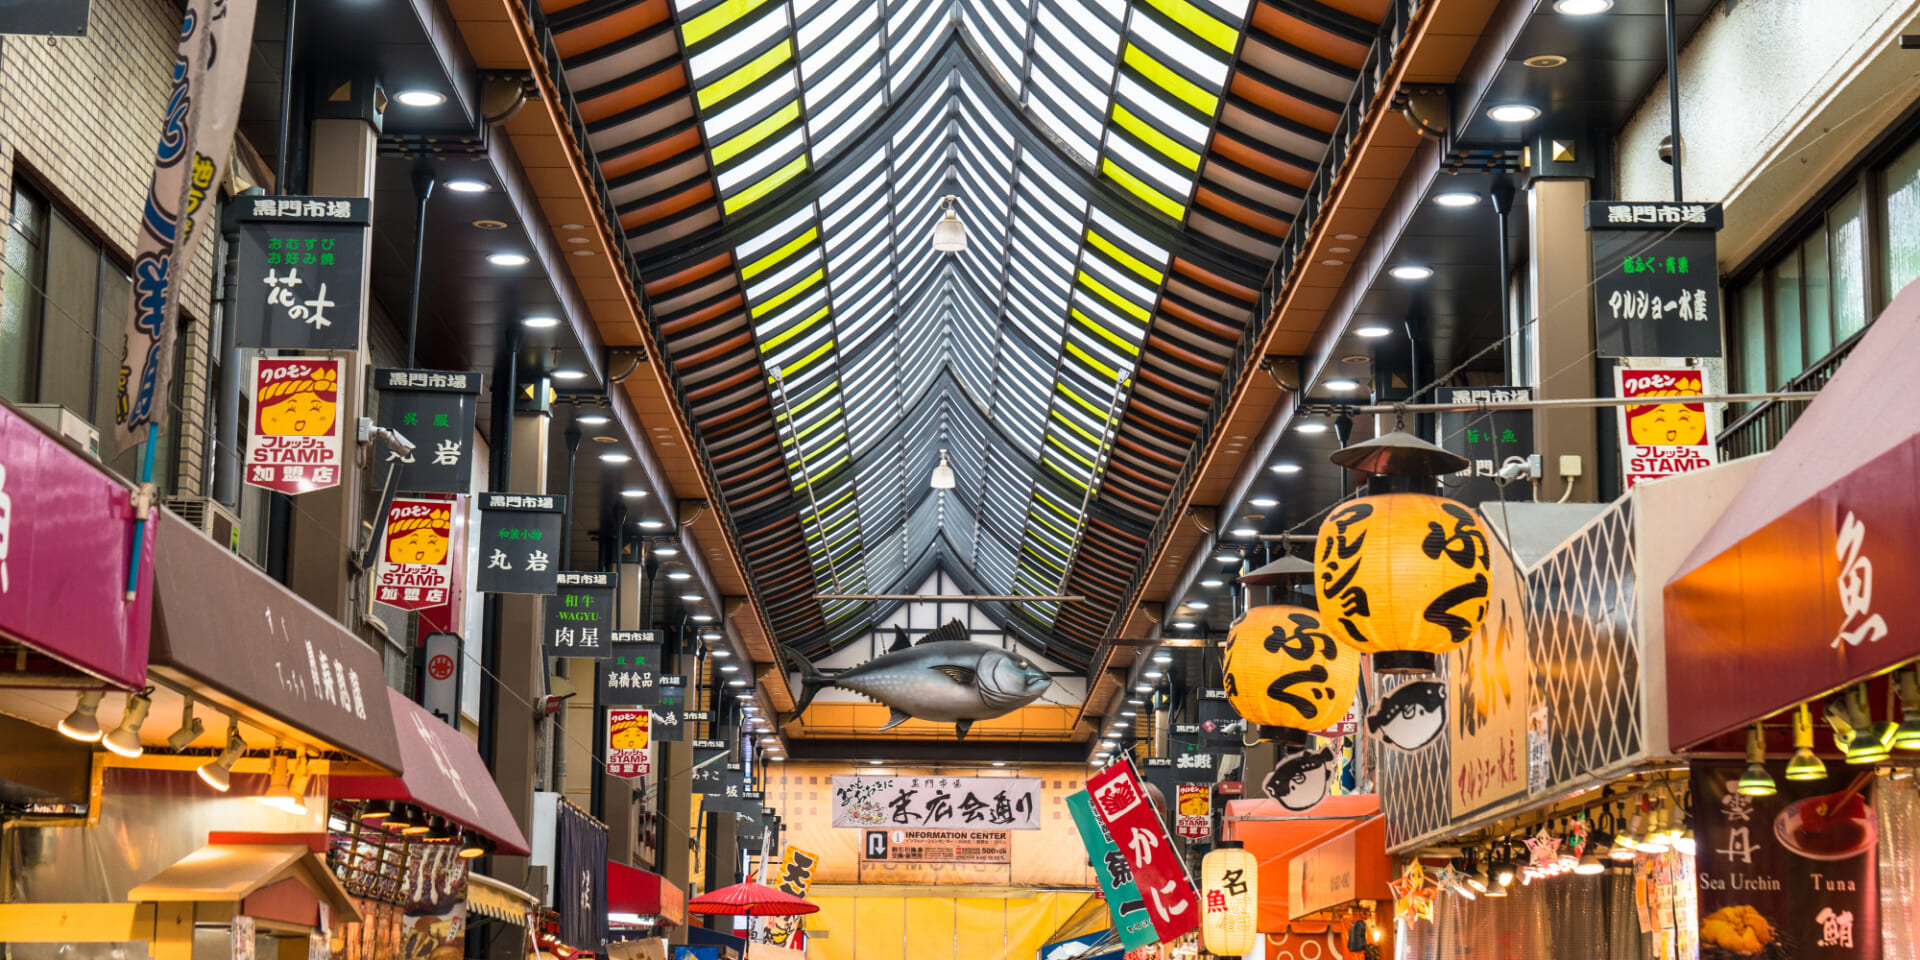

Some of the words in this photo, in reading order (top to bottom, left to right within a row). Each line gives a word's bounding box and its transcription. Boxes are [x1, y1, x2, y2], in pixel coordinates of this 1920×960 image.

[253, 201, 352, 219] 黒門市場
[1607, 205, 1707, 223] 黒門市場
[268, 238, 336, 251] おむすび
[267, 252, 336, 266] お好み焼
[264, 267, 335, 330] 花の木
[1608, 288, 1708, 322] マルショー水産
[260, 364, 312, 383] クロモン
[389, 373, 467, 389] 黒門市場
[1625, 374, 1676, 391] クロモン
[1451, 390, 1531, 404] 黒門市場
[402, 412, 449, 427] 呉服
[261, 437, 325, 449] フレッシュ
[254, 449, 334, 463] STAMP
[1636, 446, 1700, 458] フレッシュ
[1631, 459, 1710, 473] STAMP
[252, 466, 333, 483] 加盟店
[489, 495, 554, 509] 黒門市場
[390, 505, 430, 518] クロモン
[487, 548, 550, 572] 丸岩
[388, 563, 439, 575] フレッシュ
[1321, 502, 1374, 644] マルショー
[1421, 502, 1490, 644] ふぐ
[382, 575, 445, 587] STAMP
[556, 574, 607, 585] 黒門市場
[1830, 510, 1889, 649] 魚
[380, 587, 443, 603] 加盟店
[565, 594, 595, 608] 和牛
[554, 627, 600, 647] 肉星
[1264, 613, 1338, 719] ふぐ
[608, 671, 653, 688] 高橋食品
[611, 712, 637, 723] クロモン
[610, 755, 648, 763] STAMP
[609, 764, 648, 773] 加盟店
[905, 832, 968, 840] INFORMATION
[970, 832, 1007, 841] CENTER
[1128, 827, 1189, 923] かに
[1222, 869, 1248, 896] 名
[1700, 872, 1726, 890] Sea
[1730, 873, 1781, 890] Urchin
[1810, 873, 1856, 891] Tuna
[1206, 889, 1228, 913] 魚
